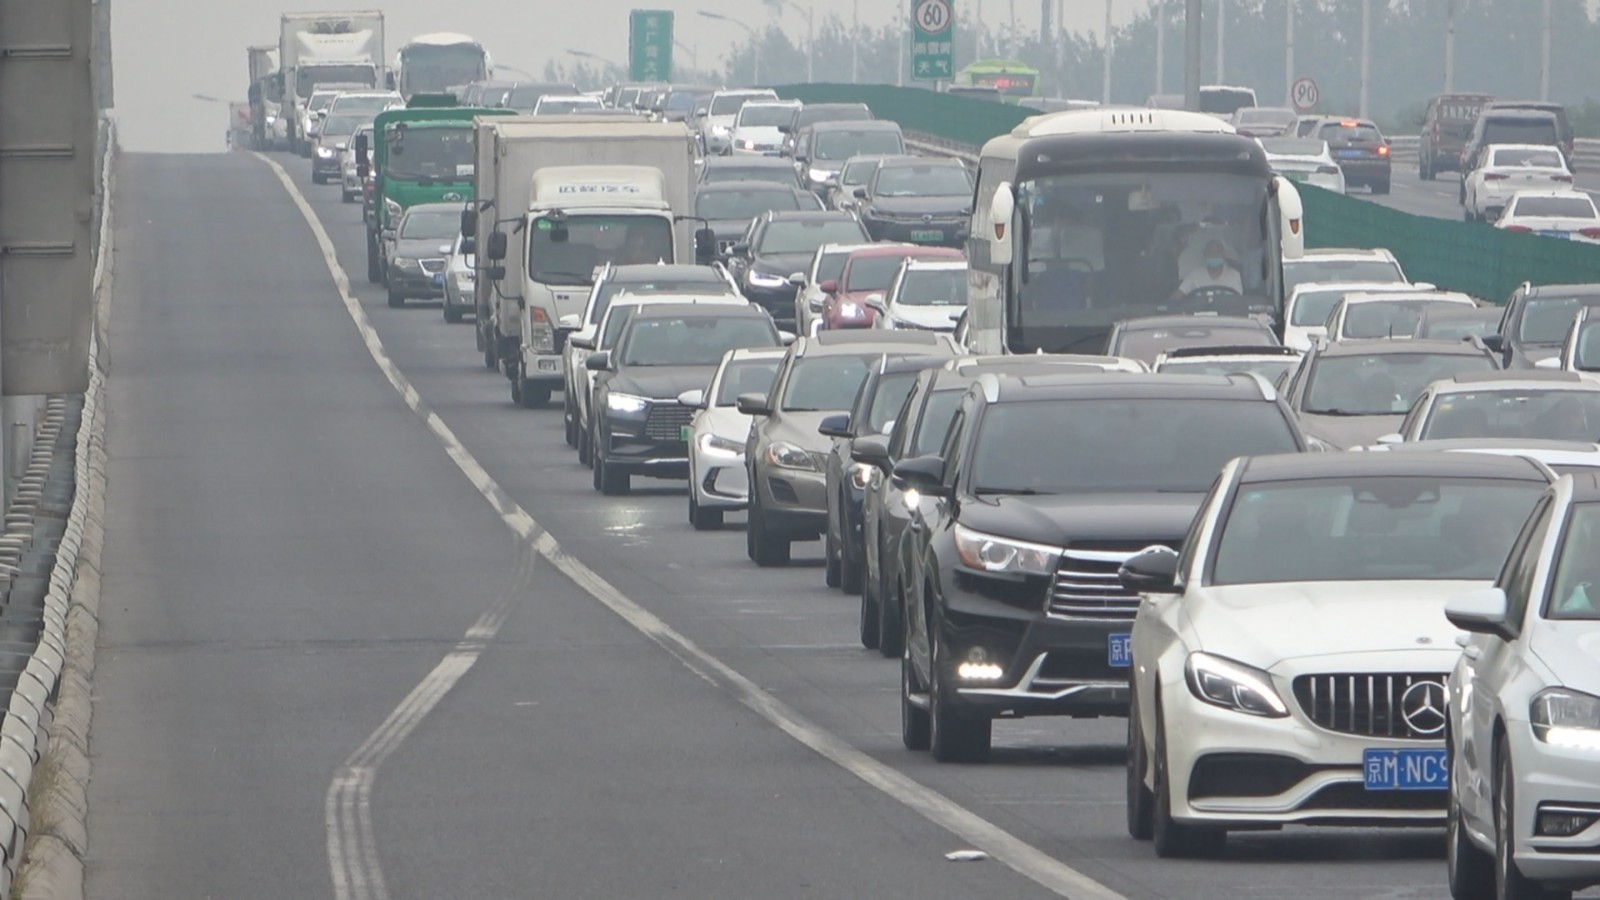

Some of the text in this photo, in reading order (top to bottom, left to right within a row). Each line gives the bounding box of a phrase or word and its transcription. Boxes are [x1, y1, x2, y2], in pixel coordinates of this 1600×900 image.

[923, 4, 942, 26] 60
[918, 60, 949, 75] 天气
[1298, 84, 1315, 102] 90
